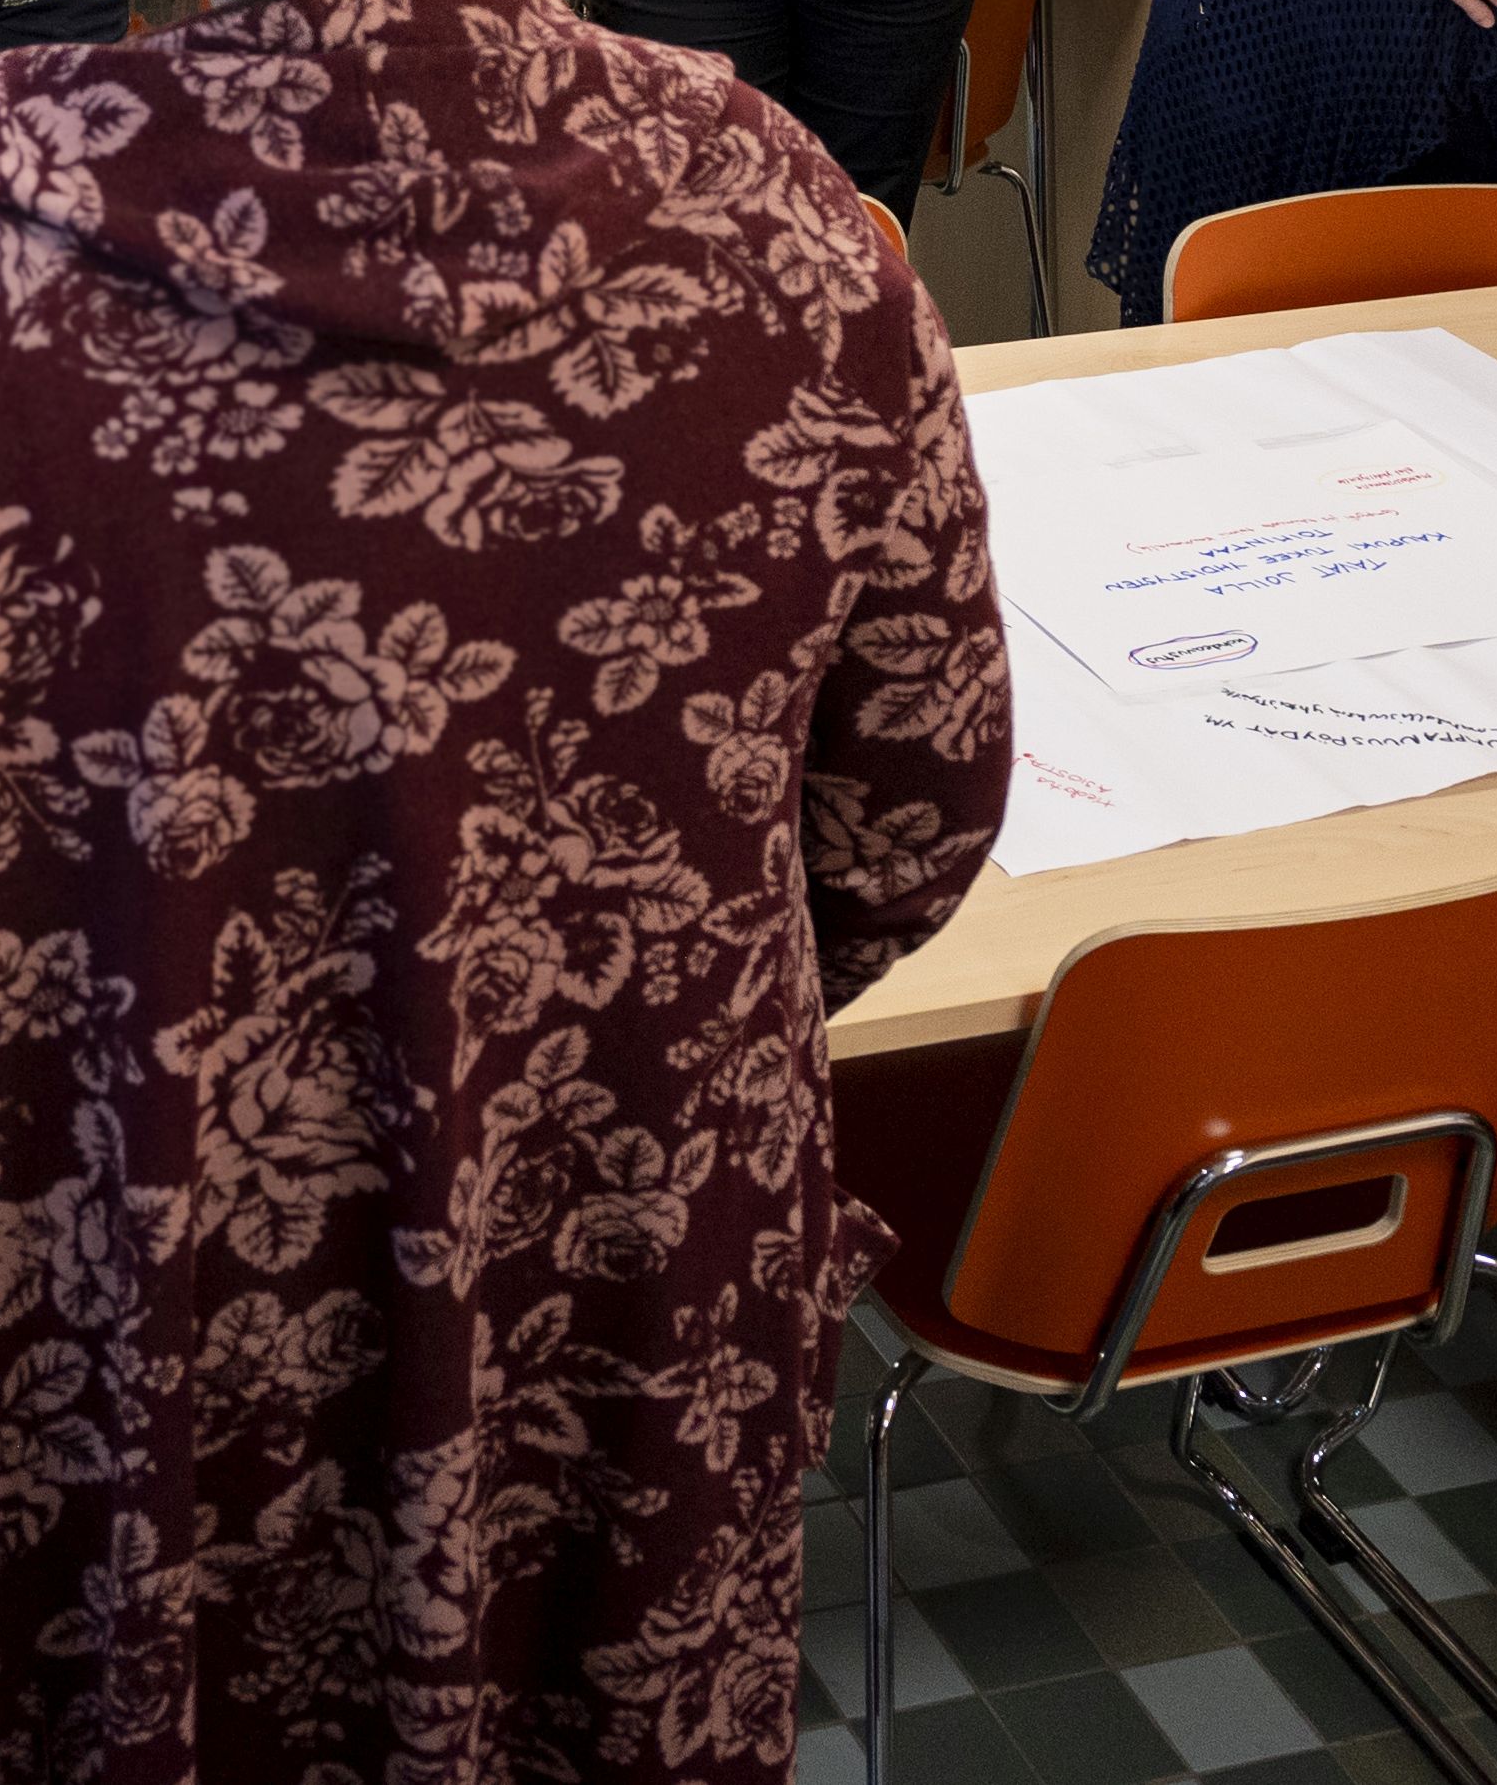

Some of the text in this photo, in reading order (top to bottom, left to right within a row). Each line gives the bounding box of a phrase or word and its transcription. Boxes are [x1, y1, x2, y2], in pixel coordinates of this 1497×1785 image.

[1197, 527, 1333, 560] TOIMINTAA
[1256, 544, 1335, 566] TUKEE
[1103, 560, 1248, 595] YHDISTYSTEN
[1202, 556, 1388, 598] TAVAT JOILLA
